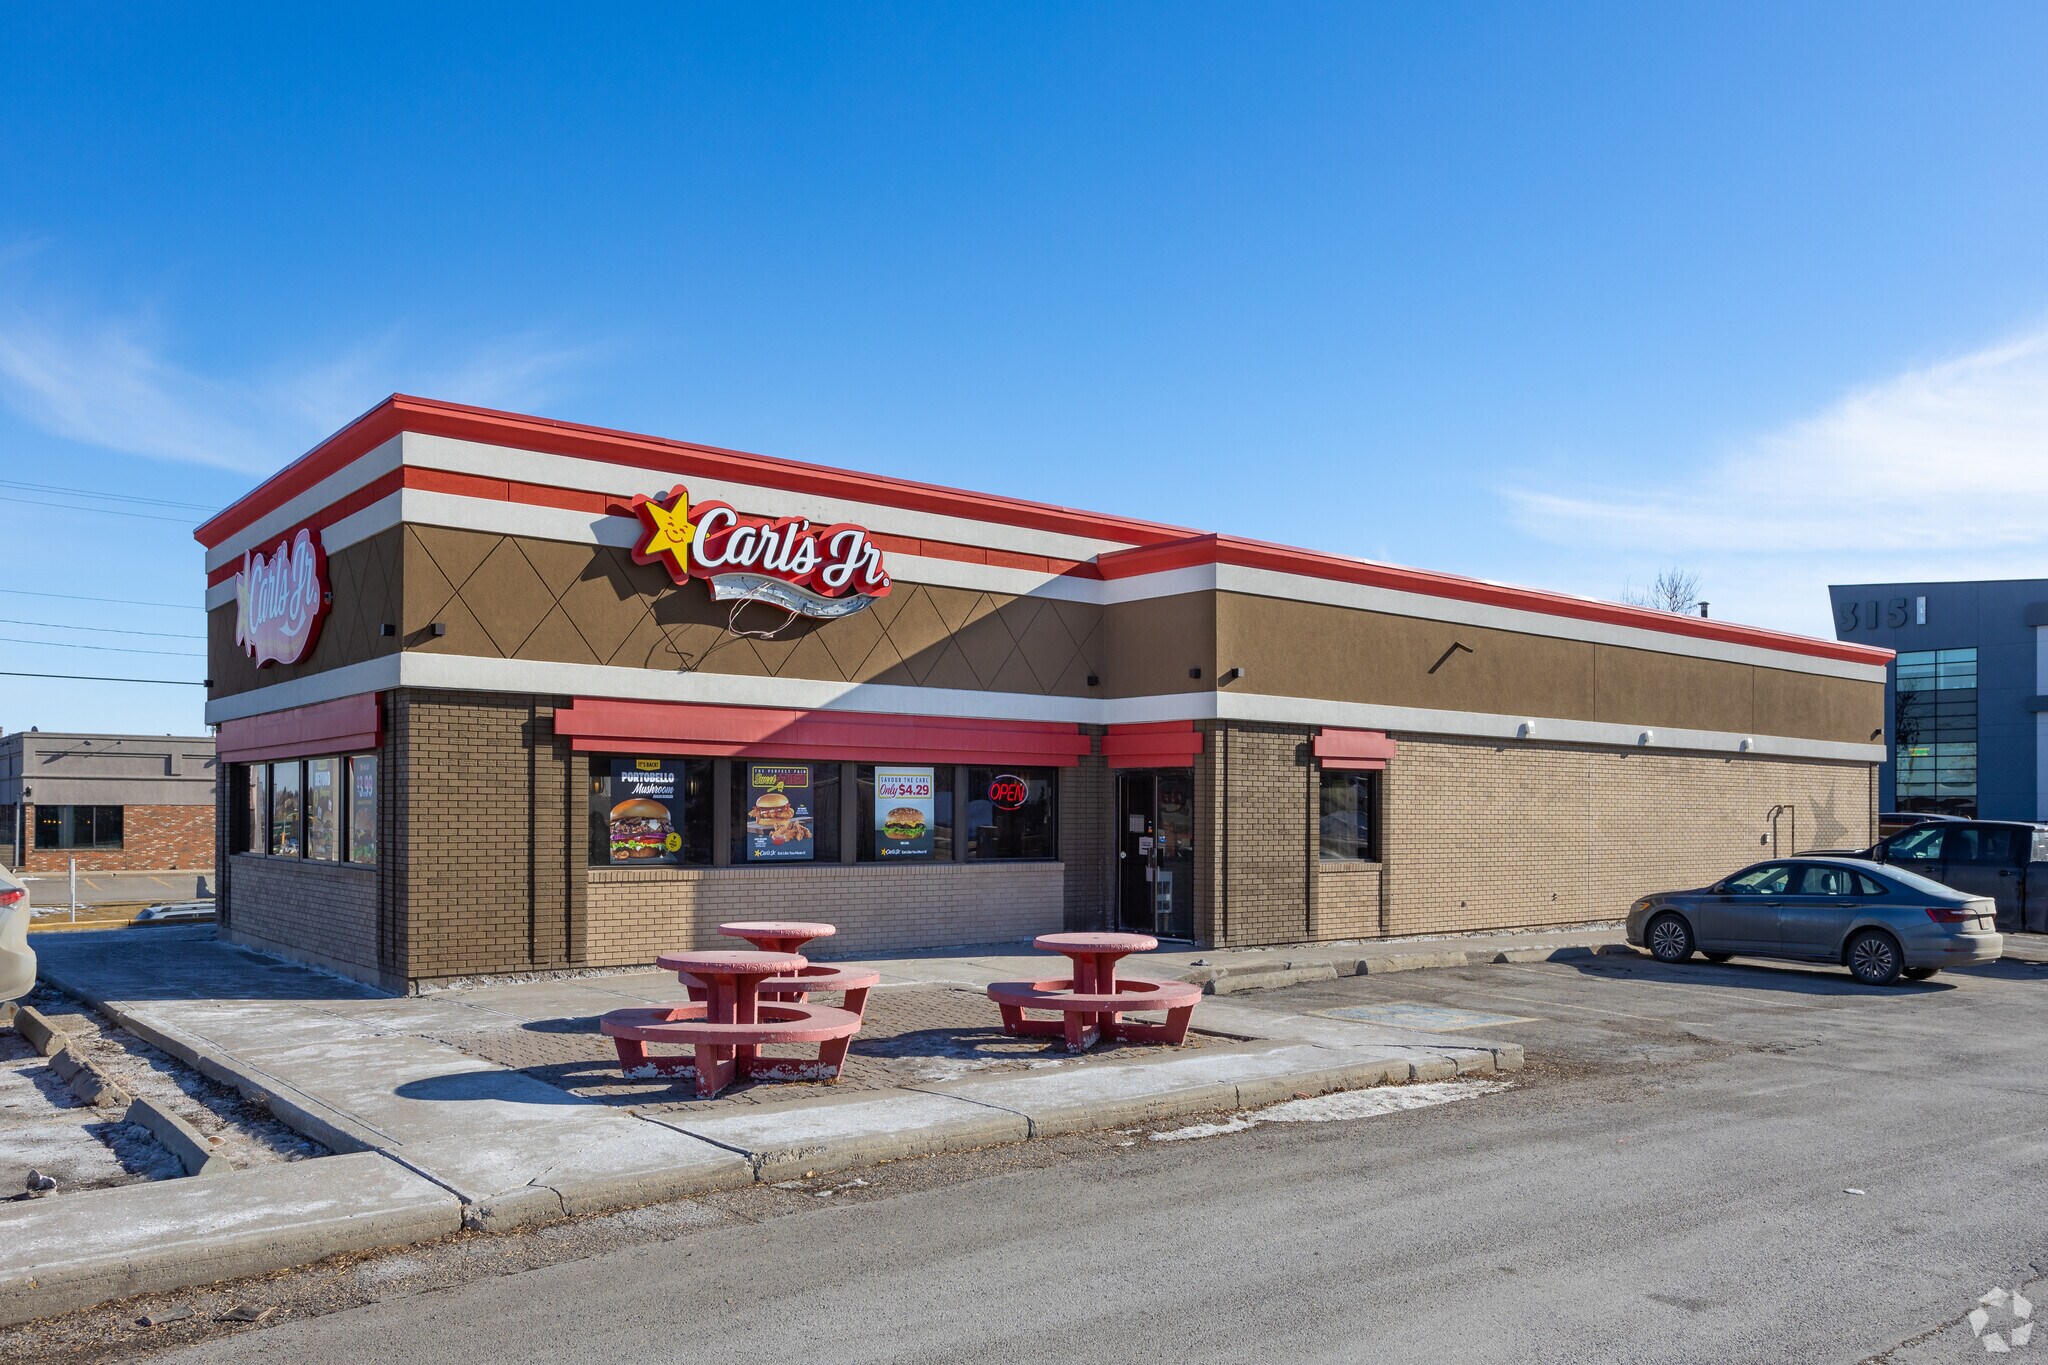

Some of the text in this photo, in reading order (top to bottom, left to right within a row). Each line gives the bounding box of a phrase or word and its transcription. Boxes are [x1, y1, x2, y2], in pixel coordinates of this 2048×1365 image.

[692, 507, 890, 588] Carl's Jr.
[249, 540, 318, 642] Carl's Jr.
[621, 771, 675, 783] PORTOBELLO
[631, 783, 674, 794] Mushroom
[880, 783, 930, 798] Only $4.29
[989, 783, 1025, 802] OPEN
